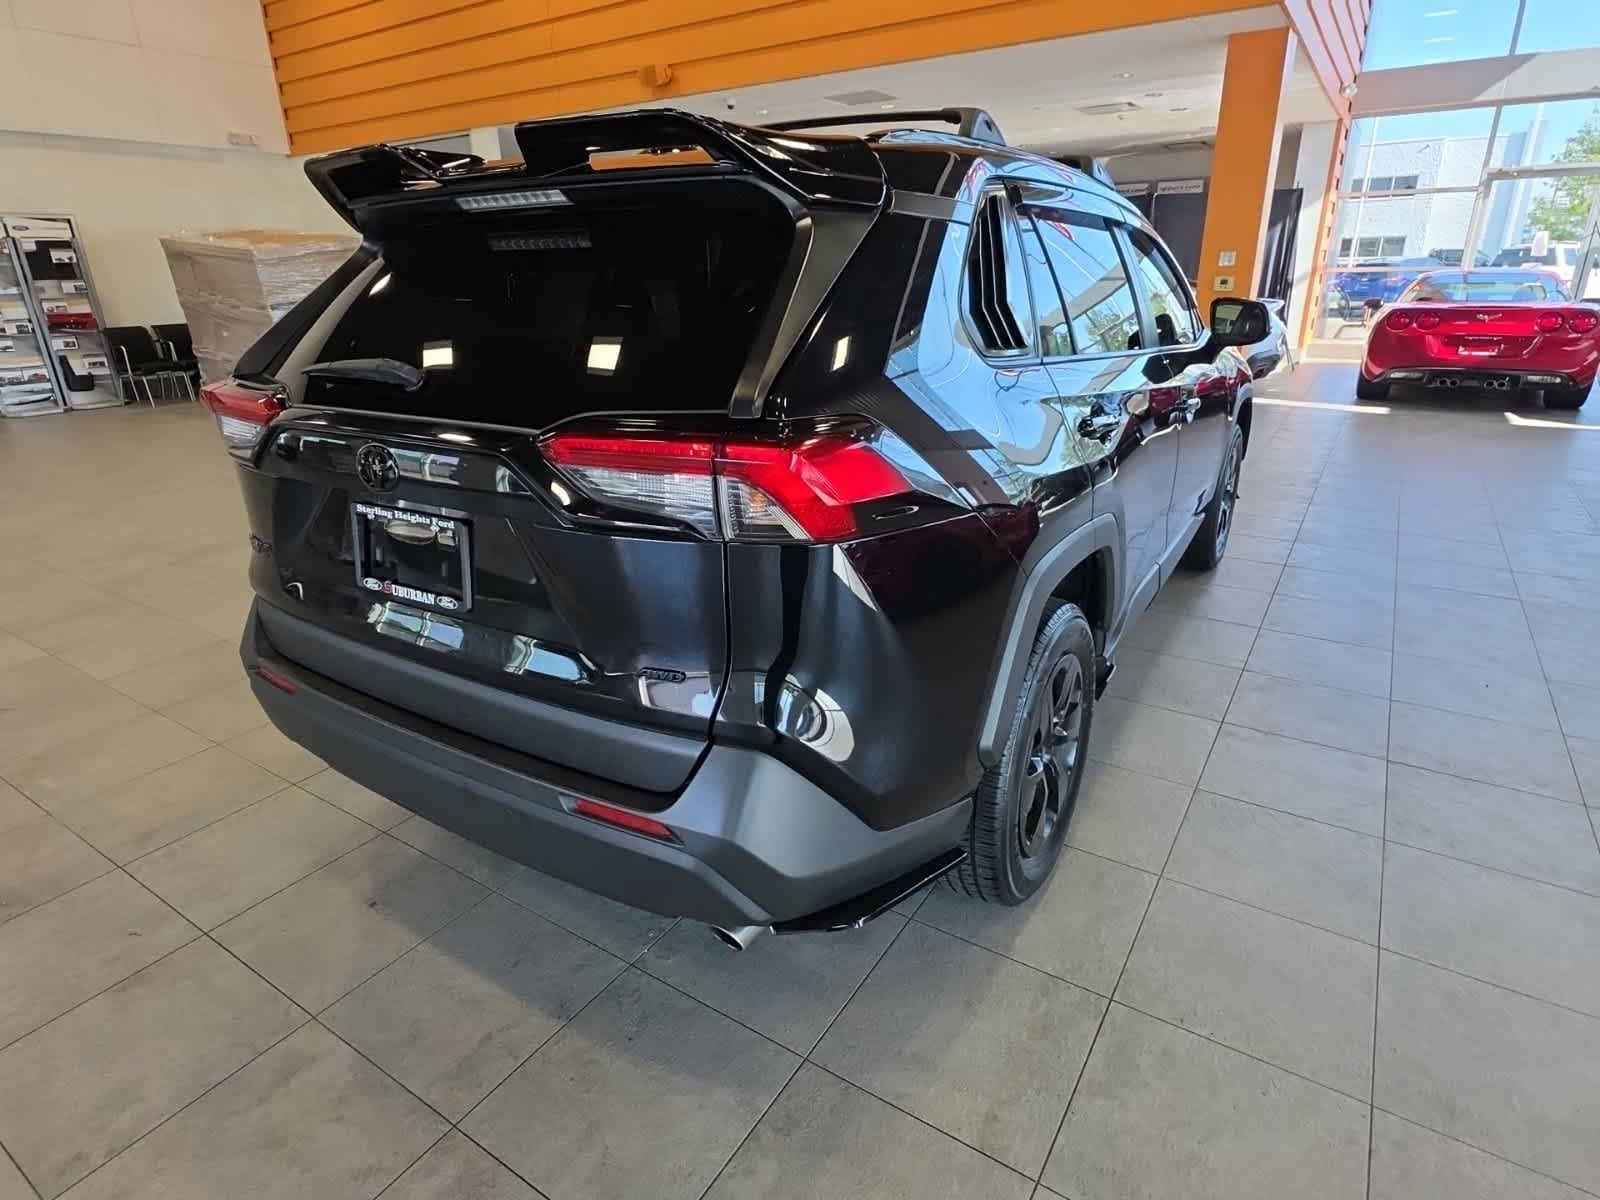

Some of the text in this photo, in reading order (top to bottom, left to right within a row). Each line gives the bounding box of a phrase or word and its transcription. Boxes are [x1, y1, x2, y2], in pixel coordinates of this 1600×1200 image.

[356, 503, 455, 529] Sterling Heights Ford
[383, 580, 435, 605] SUBURBAN
